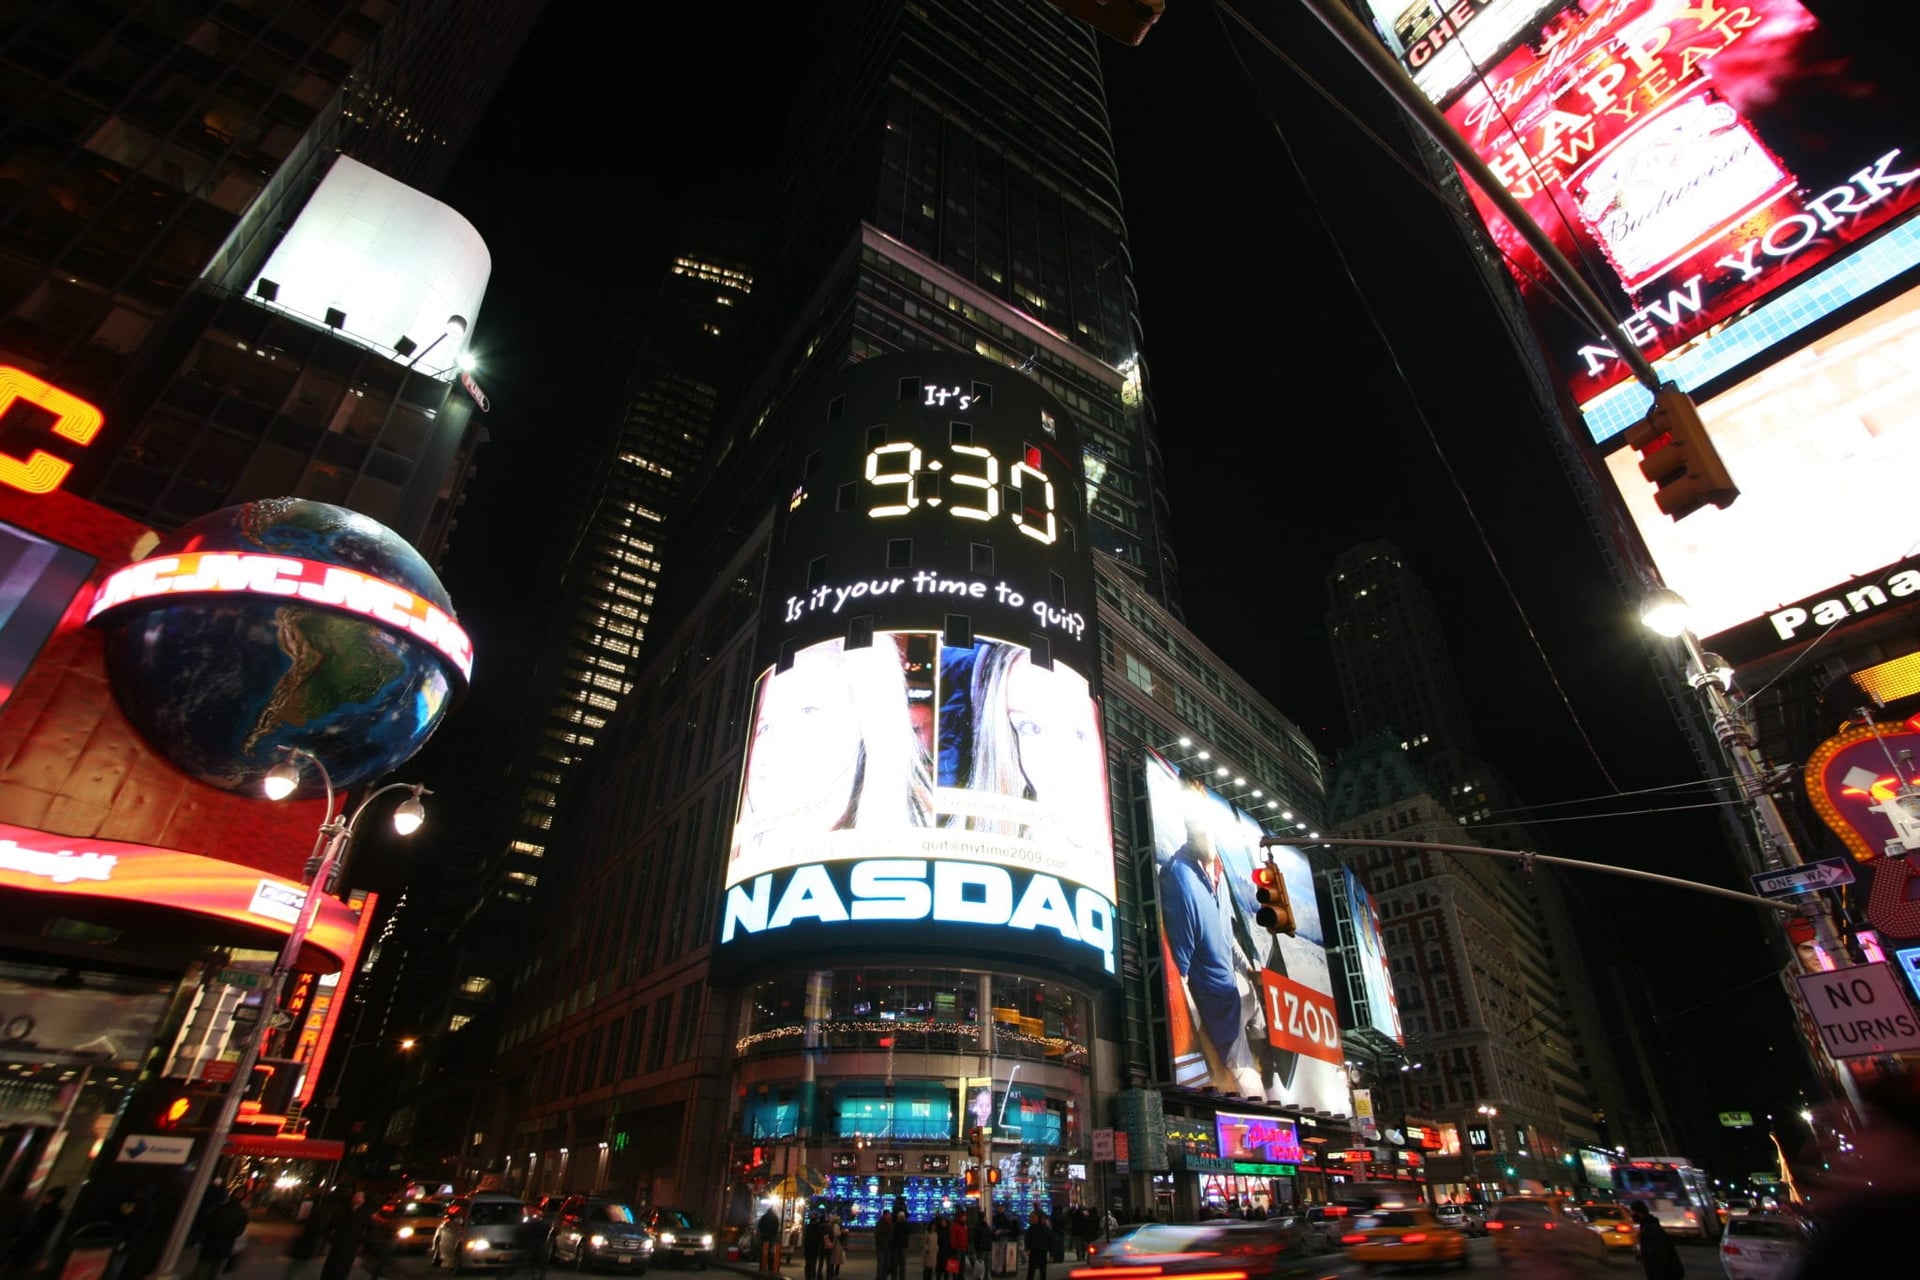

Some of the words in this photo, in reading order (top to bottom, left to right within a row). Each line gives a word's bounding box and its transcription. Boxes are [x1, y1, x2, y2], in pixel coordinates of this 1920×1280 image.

[1409, 0, 1492, 67] CHE
[1487, 0, 1727, 188] HAPPY
[1510, 126, 1597, 200] NEW
[1603, 7, 1761, 123] YEAR
[1604, 140, 1753, 244] Budweiser
[1577, 275, 1703, 377] NEW
[1716, 148, 1920, 283] YORK
[923, 384, 971, 411] It's
[865, 441, 1057, 545] 9:30
[784, 596, 804, 623] Is
[811, 587, 832, 612] it
[832, 577, 905, 614] your
[912, 570, 987, 599] time
[994, 580, 1025, 608] to
[1031, 599, 1085, 642] quit?
[1769, 569, 1920, 641] Pana
[1767, 876, 1794, 890] ONE
[1804, 867, 1834, 883] WAY
[720, 859, 1115, 975] NASDAQ
[1267, 984, 1339, 1050] IZOD
[1822, 1014, 1917, 1046] TURNS
[1823, 978, 1875, 1010] NO
[1469, 1129, 1487, 1146] GAP
